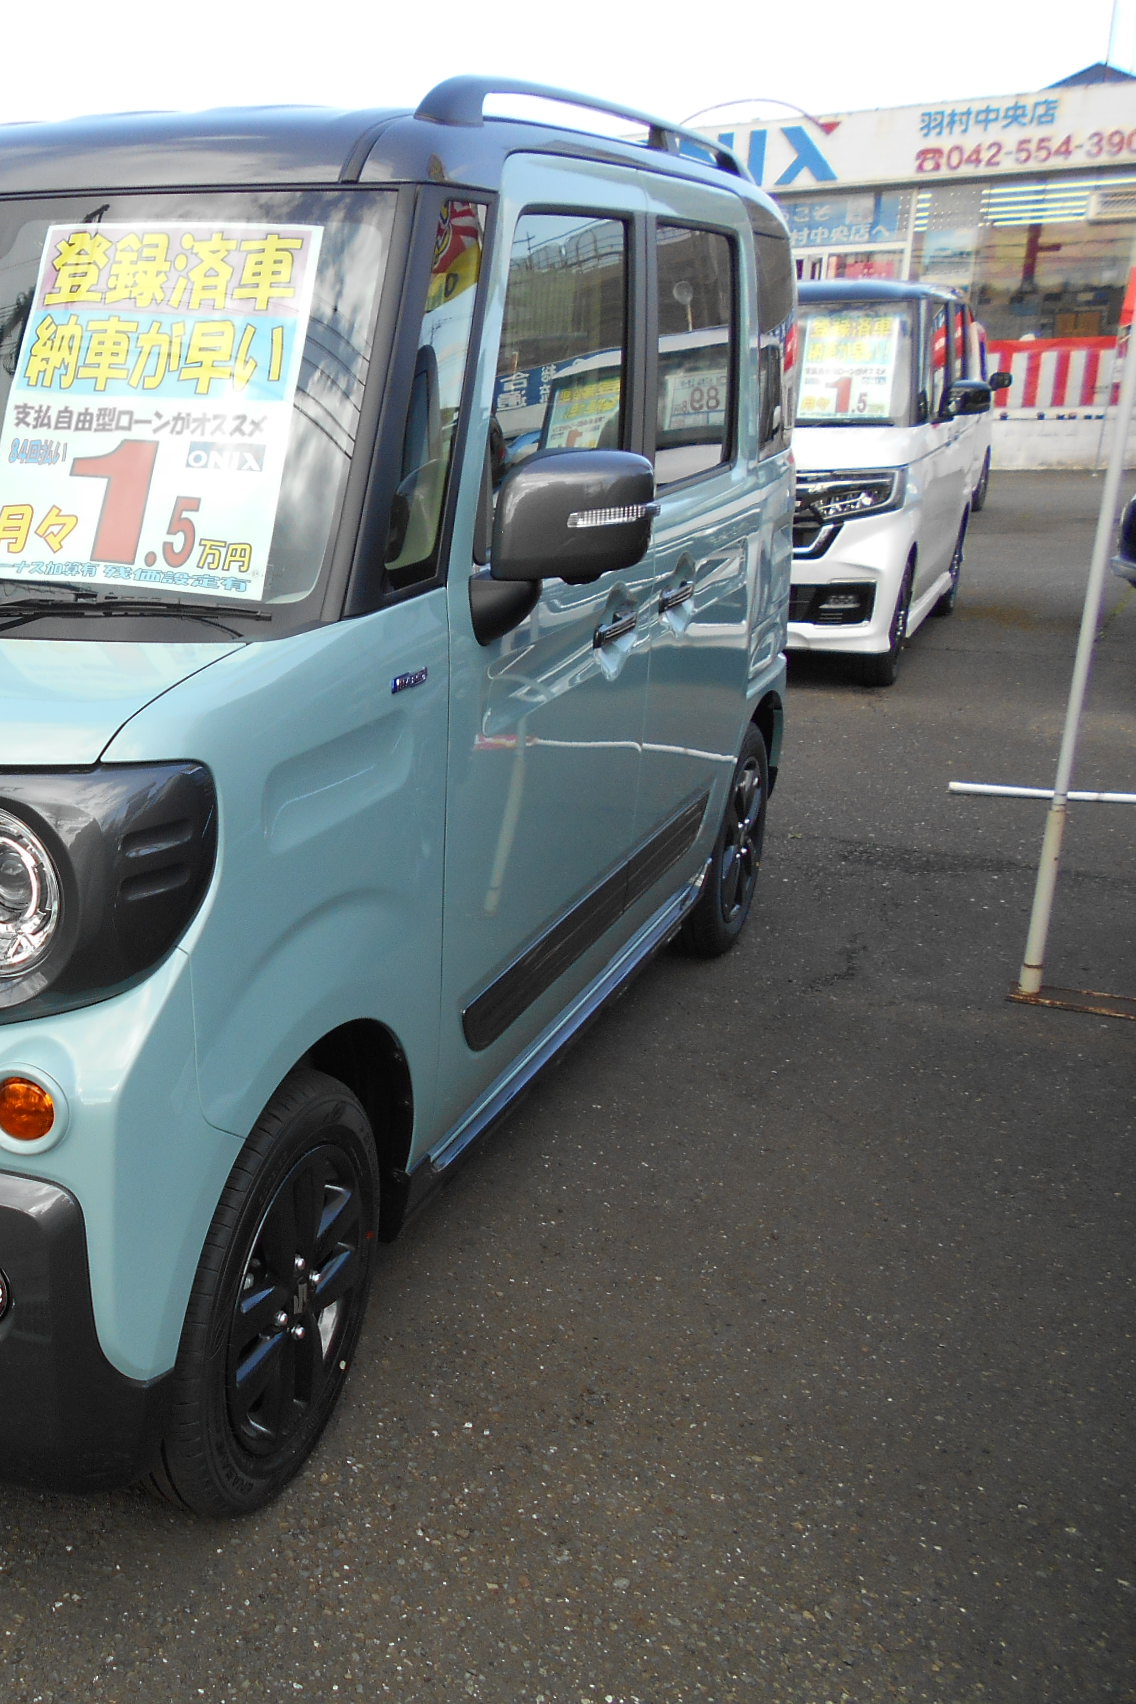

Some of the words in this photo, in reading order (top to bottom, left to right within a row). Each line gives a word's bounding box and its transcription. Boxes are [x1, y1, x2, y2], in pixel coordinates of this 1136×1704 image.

[919, 99, 1060, 137] 羽村中央店
[44, 231, 304, 311] 登録済車
[24, 314, 284, 394] 納車が早い
[13, 404, 268, 436] 支払自由型ローンがオススメ
[197, 539, 253, 573] 万円
